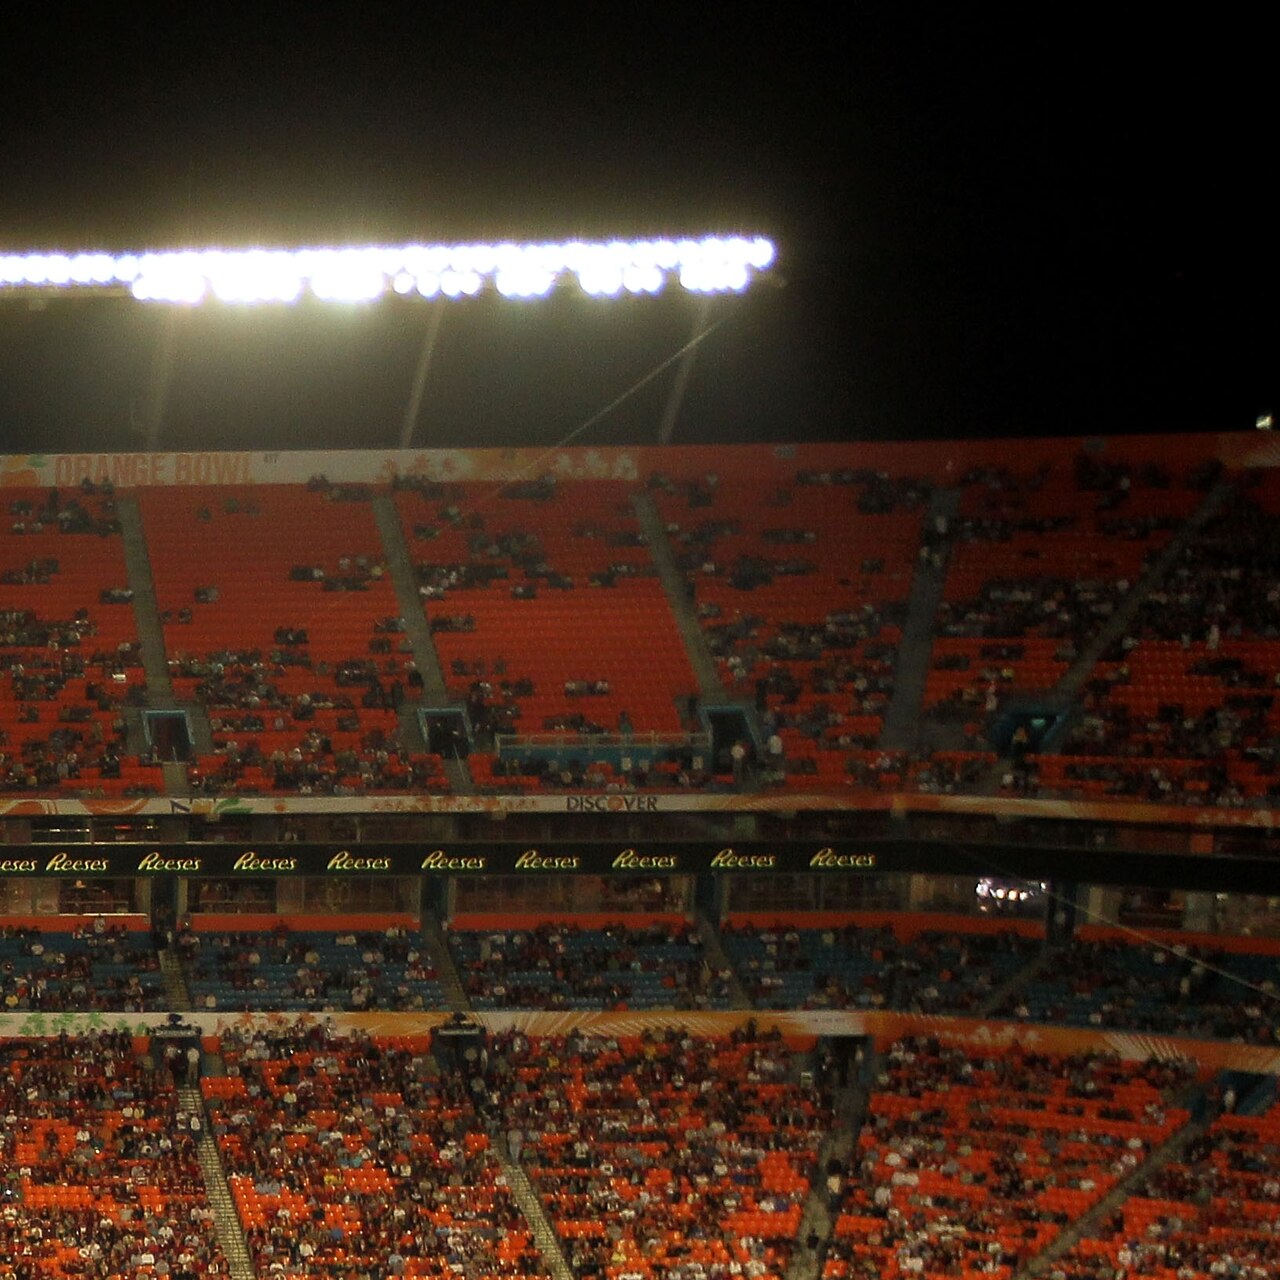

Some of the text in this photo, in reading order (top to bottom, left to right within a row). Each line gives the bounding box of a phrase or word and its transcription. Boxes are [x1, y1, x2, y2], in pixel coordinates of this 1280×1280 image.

[55, 453, 253, 486] ORANGE BOWL
[566, 797, 657, 811] DISCOVER
